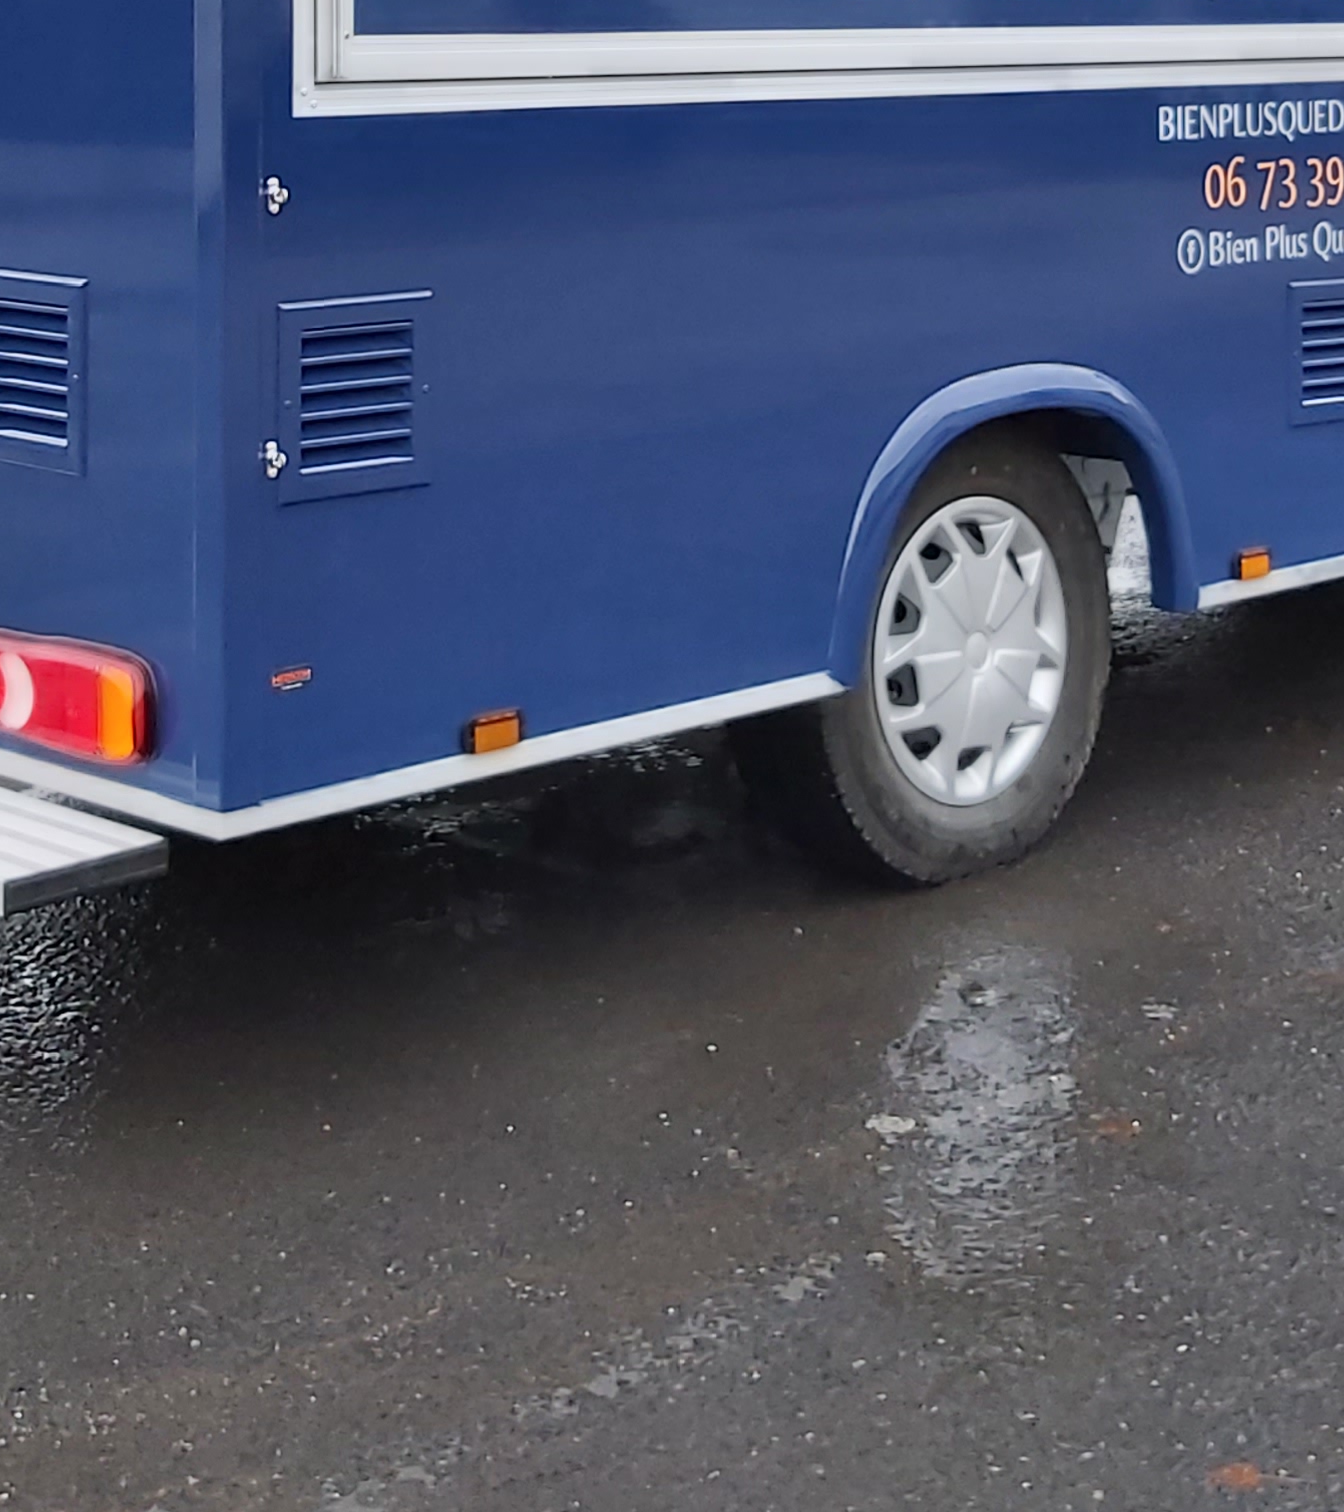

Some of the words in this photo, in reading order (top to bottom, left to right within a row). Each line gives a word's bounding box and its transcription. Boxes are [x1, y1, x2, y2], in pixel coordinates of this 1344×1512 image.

[1204, 156, 1247, 209] 06
[1256, 157, 1298, 211] 73
[1306, 156, 1344, 208] 39
[1208, 229, 1258, 267] Bien
[1265, 224, 1307, 261] Plus
